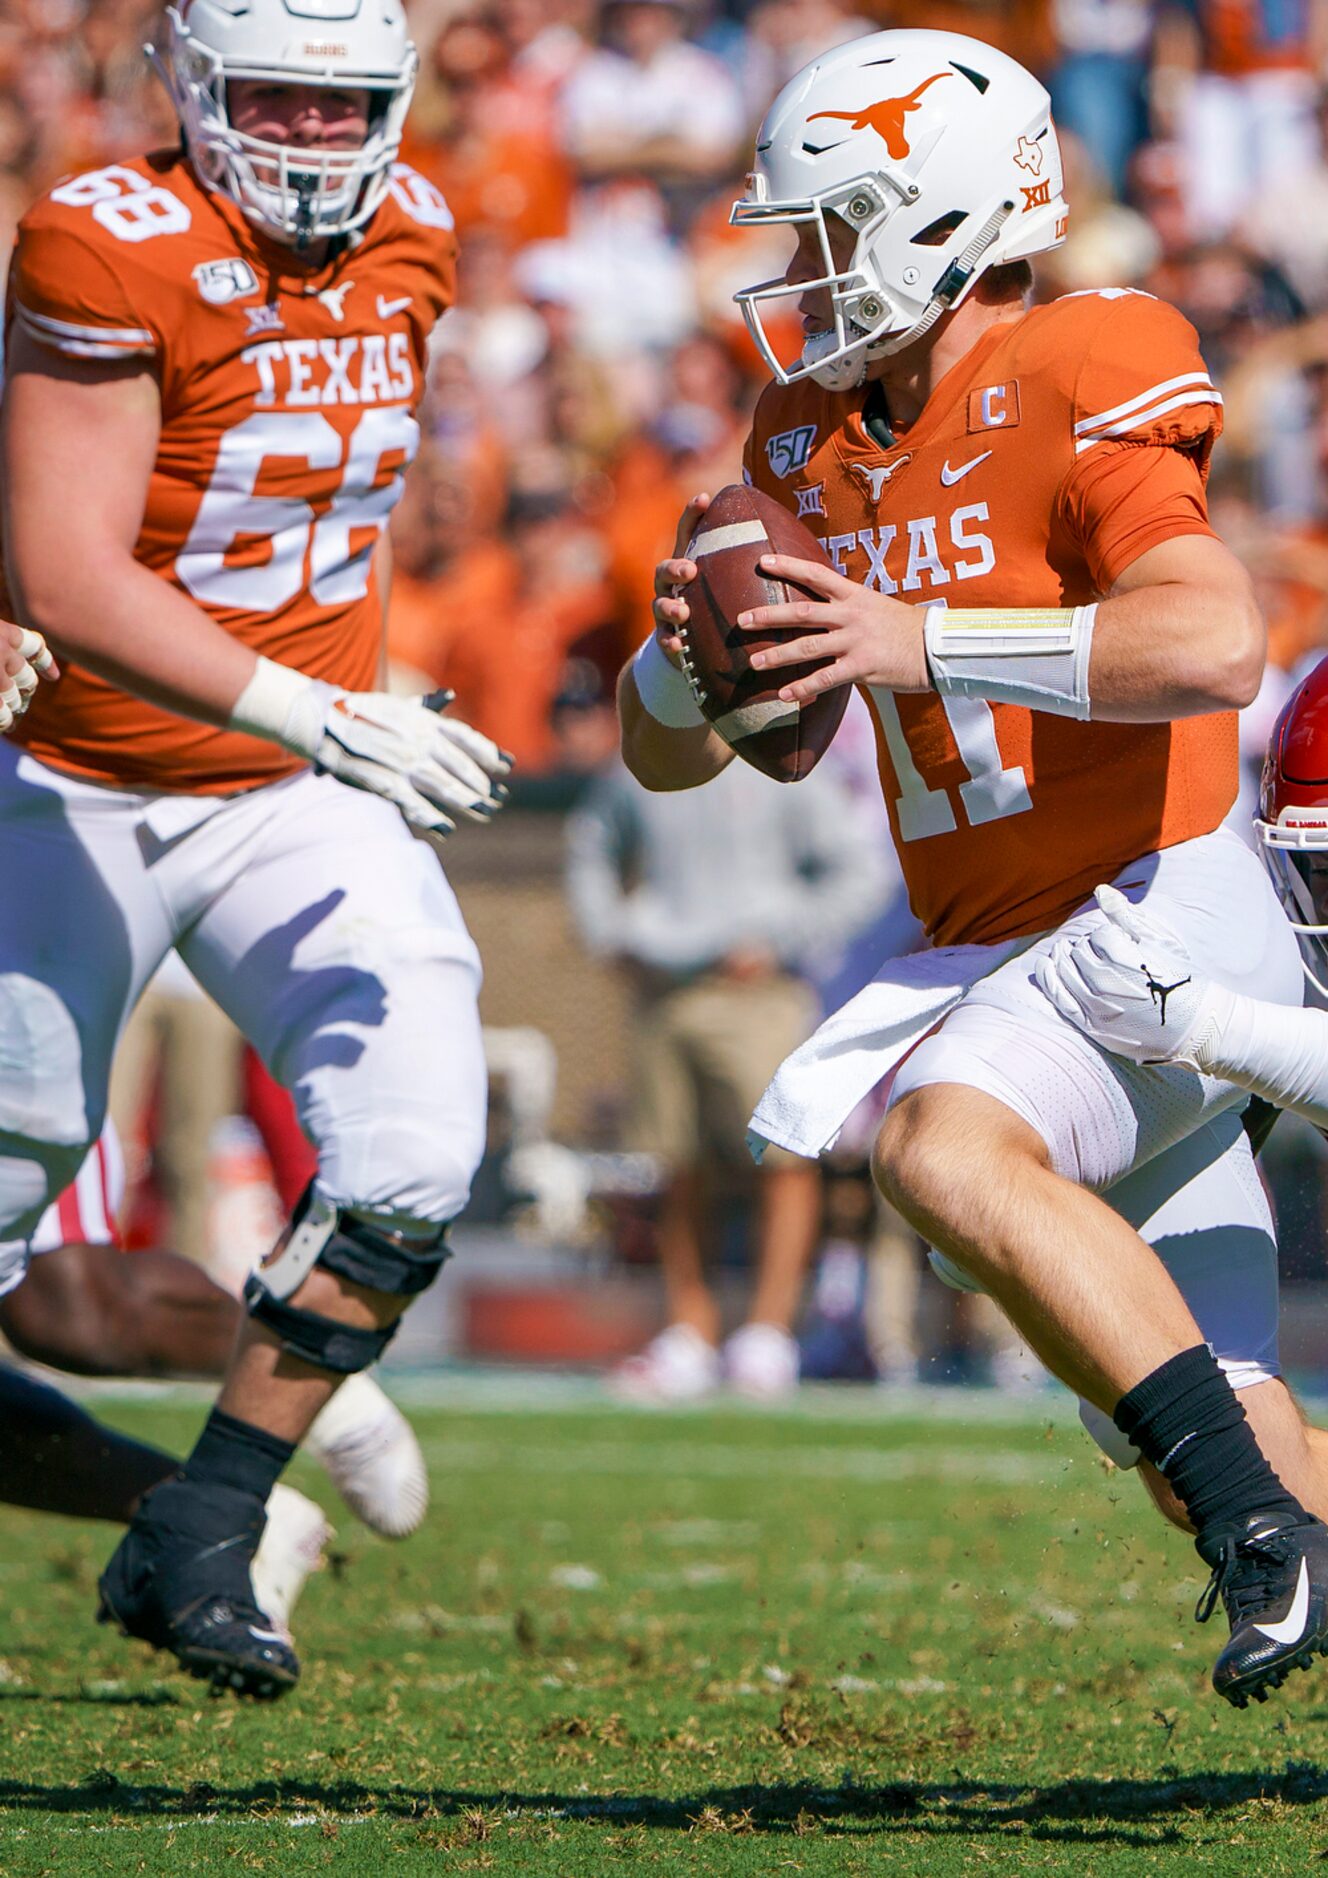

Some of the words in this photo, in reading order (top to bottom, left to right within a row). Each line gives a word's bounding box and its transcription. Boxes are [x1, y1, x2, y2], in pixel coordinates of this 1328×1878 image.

[50, 164, 192, 243] 68
[1019, 178, 1051, 213] XII
[241, 332, 414, 407] TEXAS
[982, 385, 1006, 426] C
[765, 424, 817, 479] 150
[793, 484, 824, 520] XII
